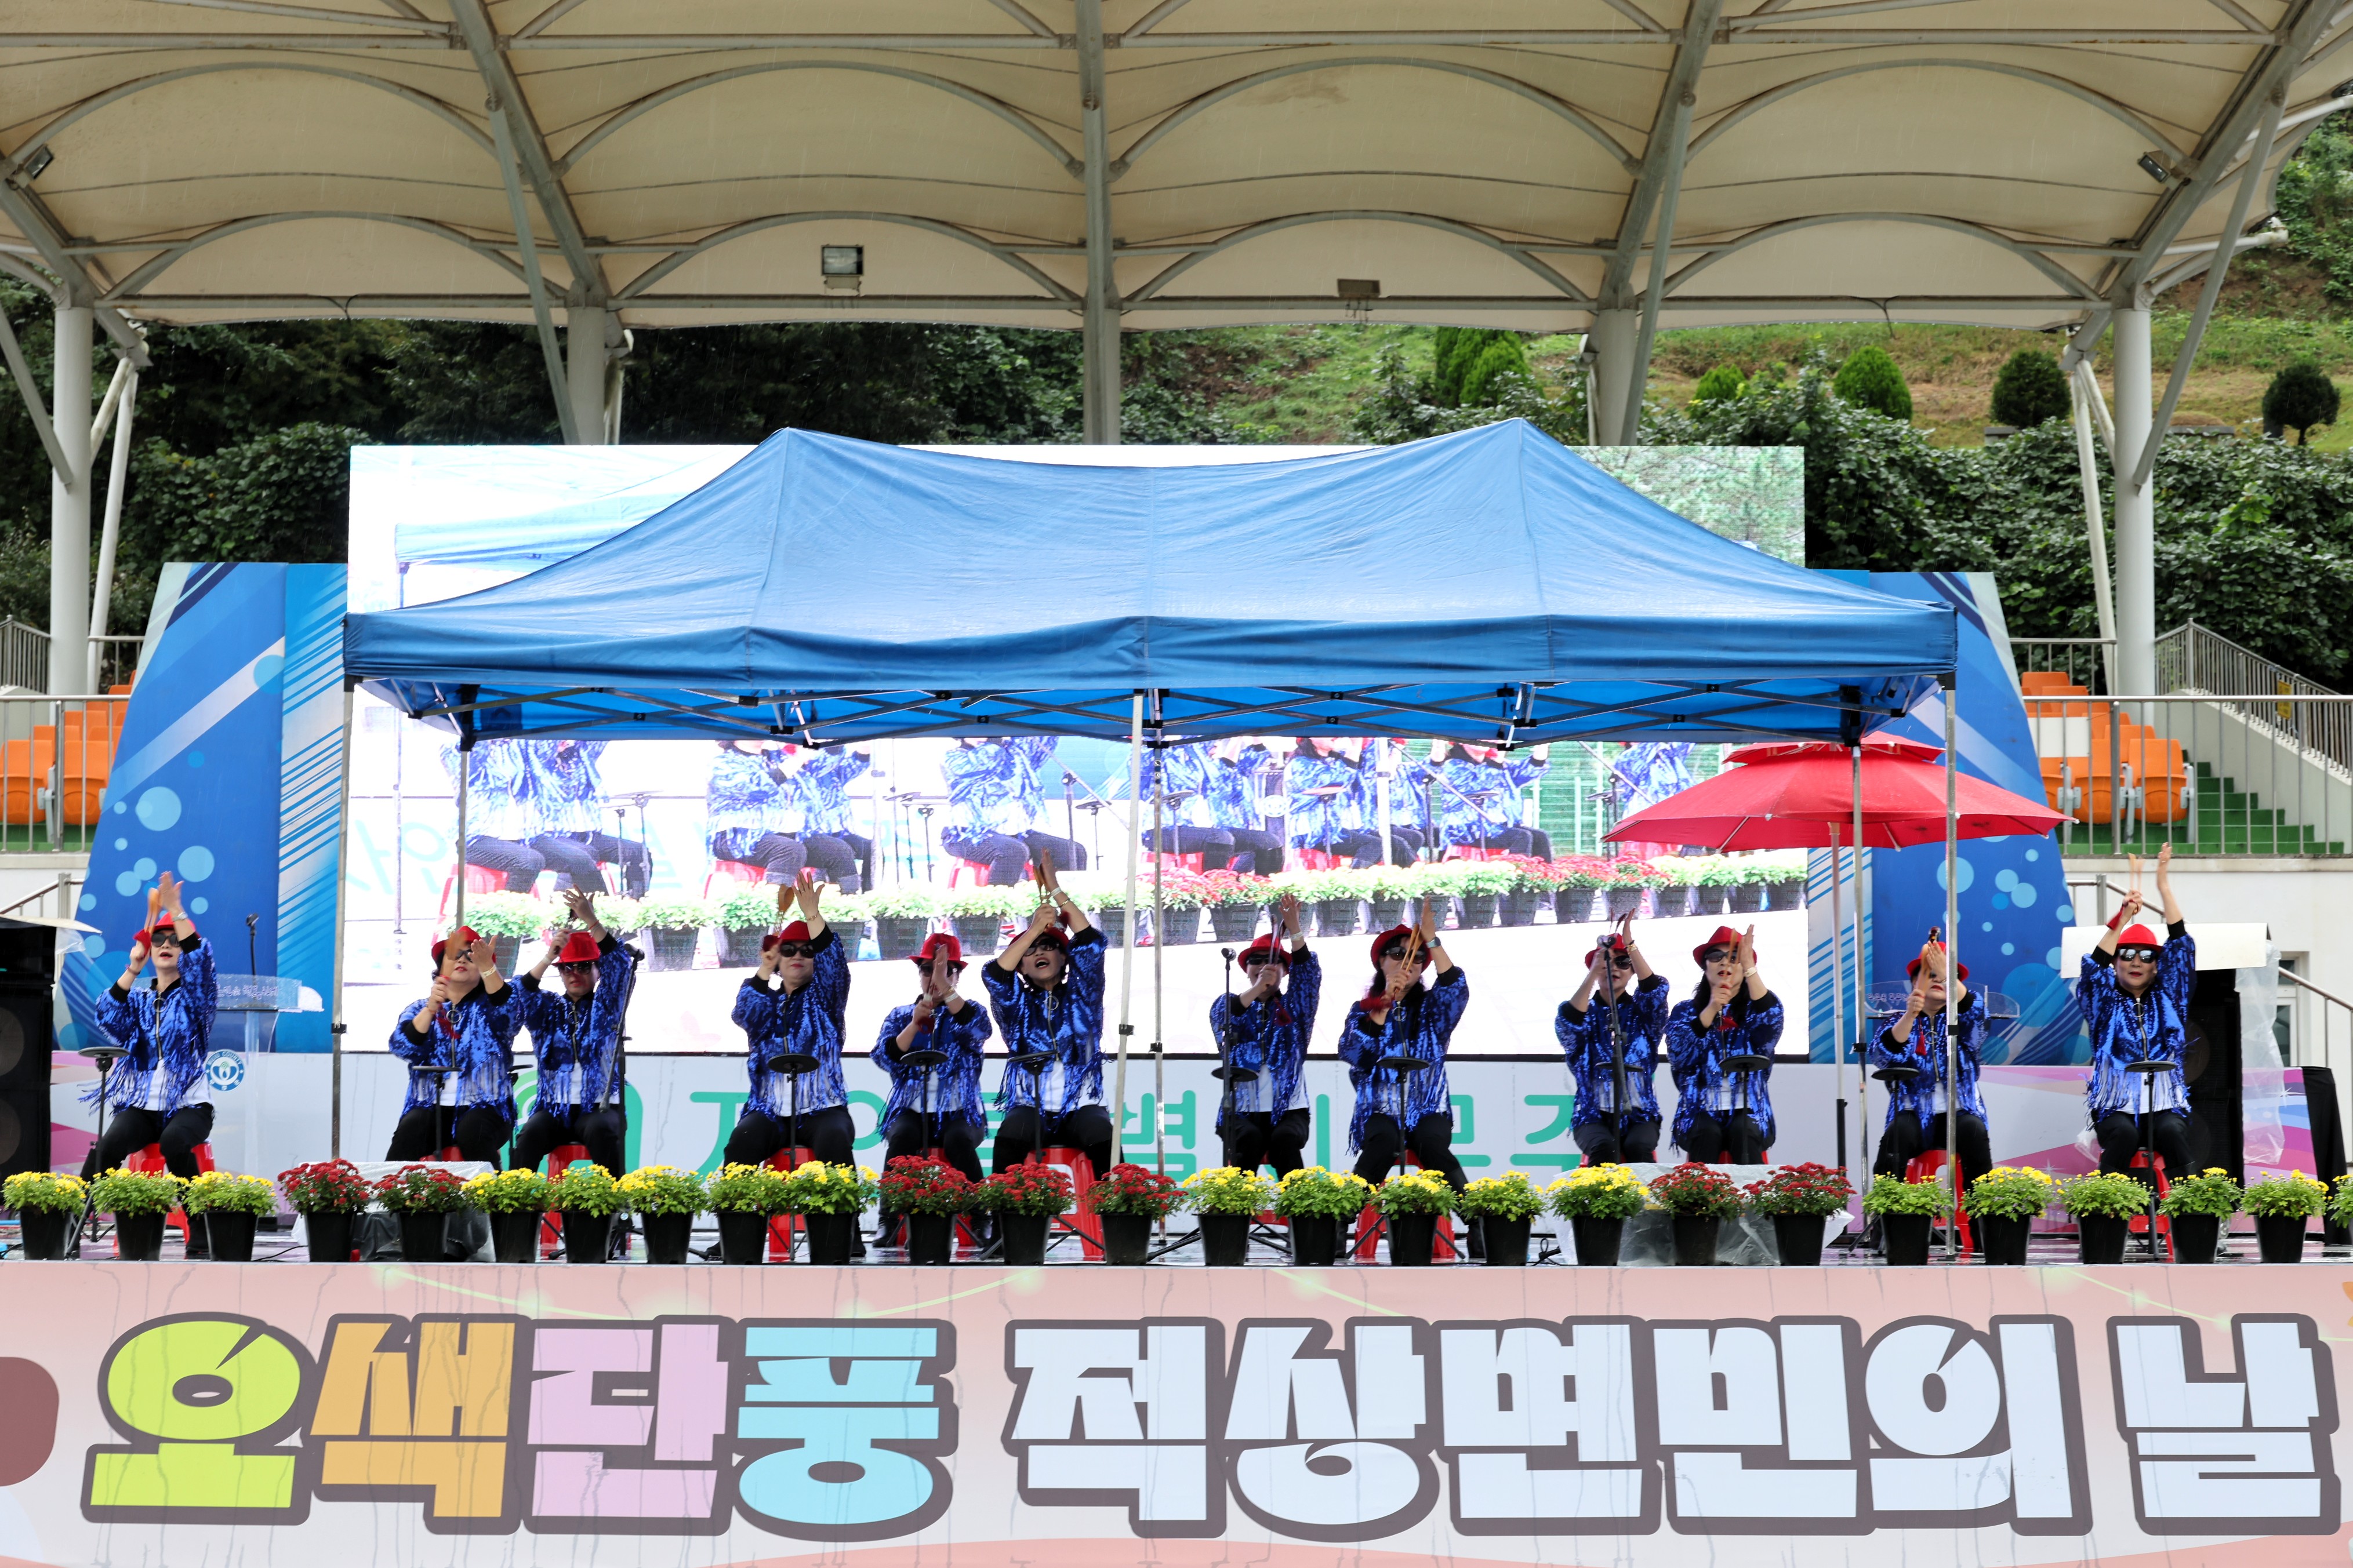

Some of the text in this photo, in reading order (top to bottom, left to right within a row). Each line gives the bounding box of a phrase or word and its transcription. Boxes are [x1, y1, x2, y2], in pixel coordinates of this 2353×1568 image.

[81, 1311, 2341, 1542] 오색단풍 적상면민의 날
